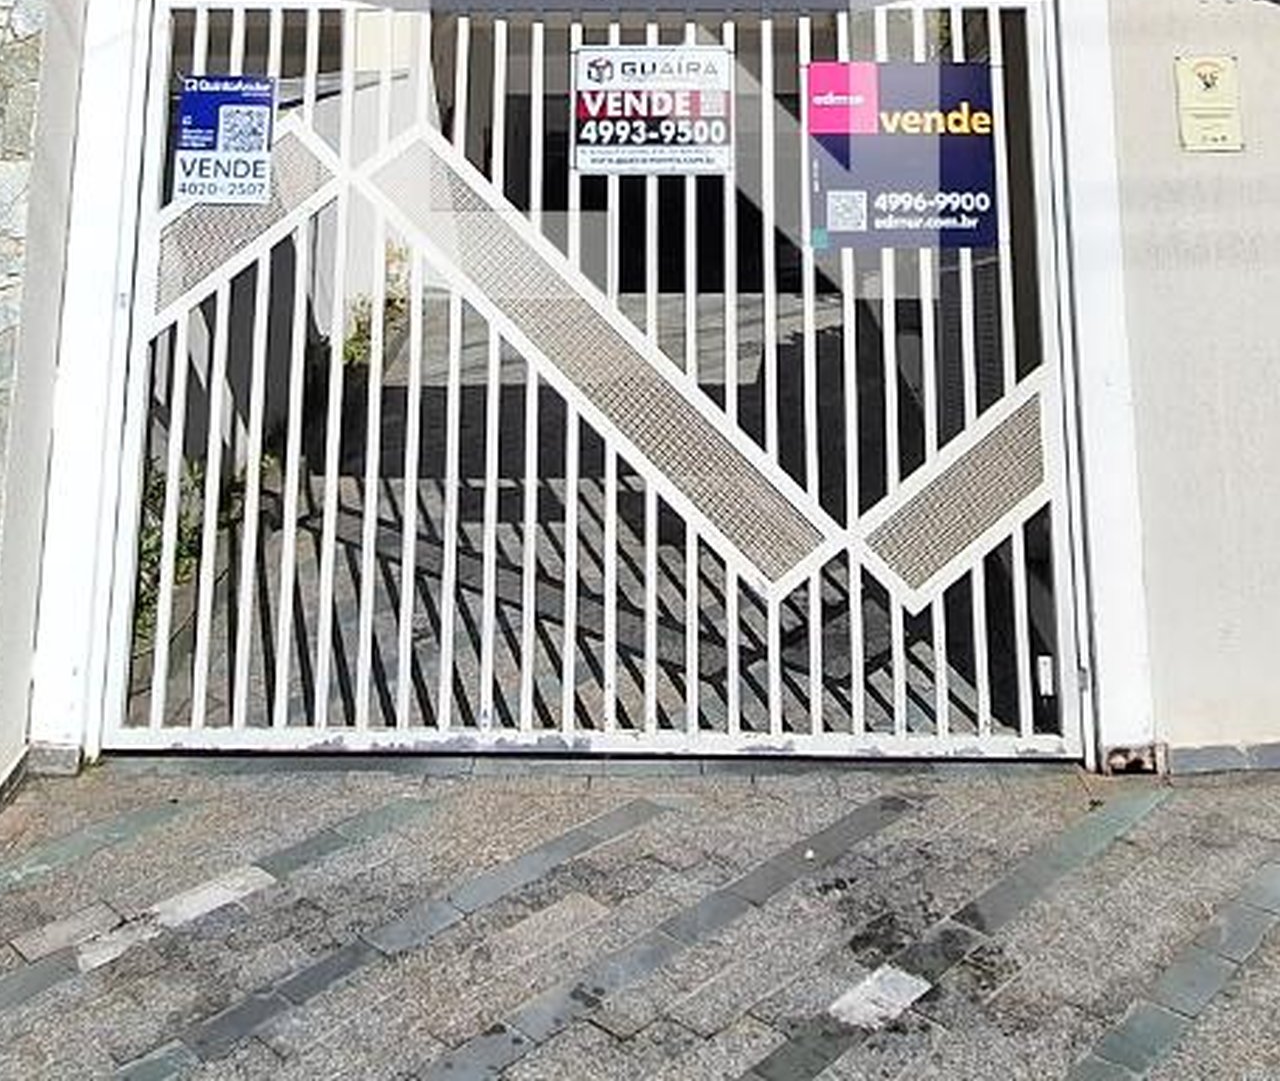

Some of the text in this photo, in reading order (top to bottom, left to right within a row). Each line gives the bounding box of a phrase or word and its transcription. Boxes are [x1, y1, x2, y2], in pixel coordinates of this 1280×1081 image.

[582, 93, 692, 117] VENDE
[879, 101, 991, 134] vende
[579, 120, 726, 144] 4993-9500
[179, 158, 266, 178] VENDE
[873, 192, 990, 212] 4996-9900
